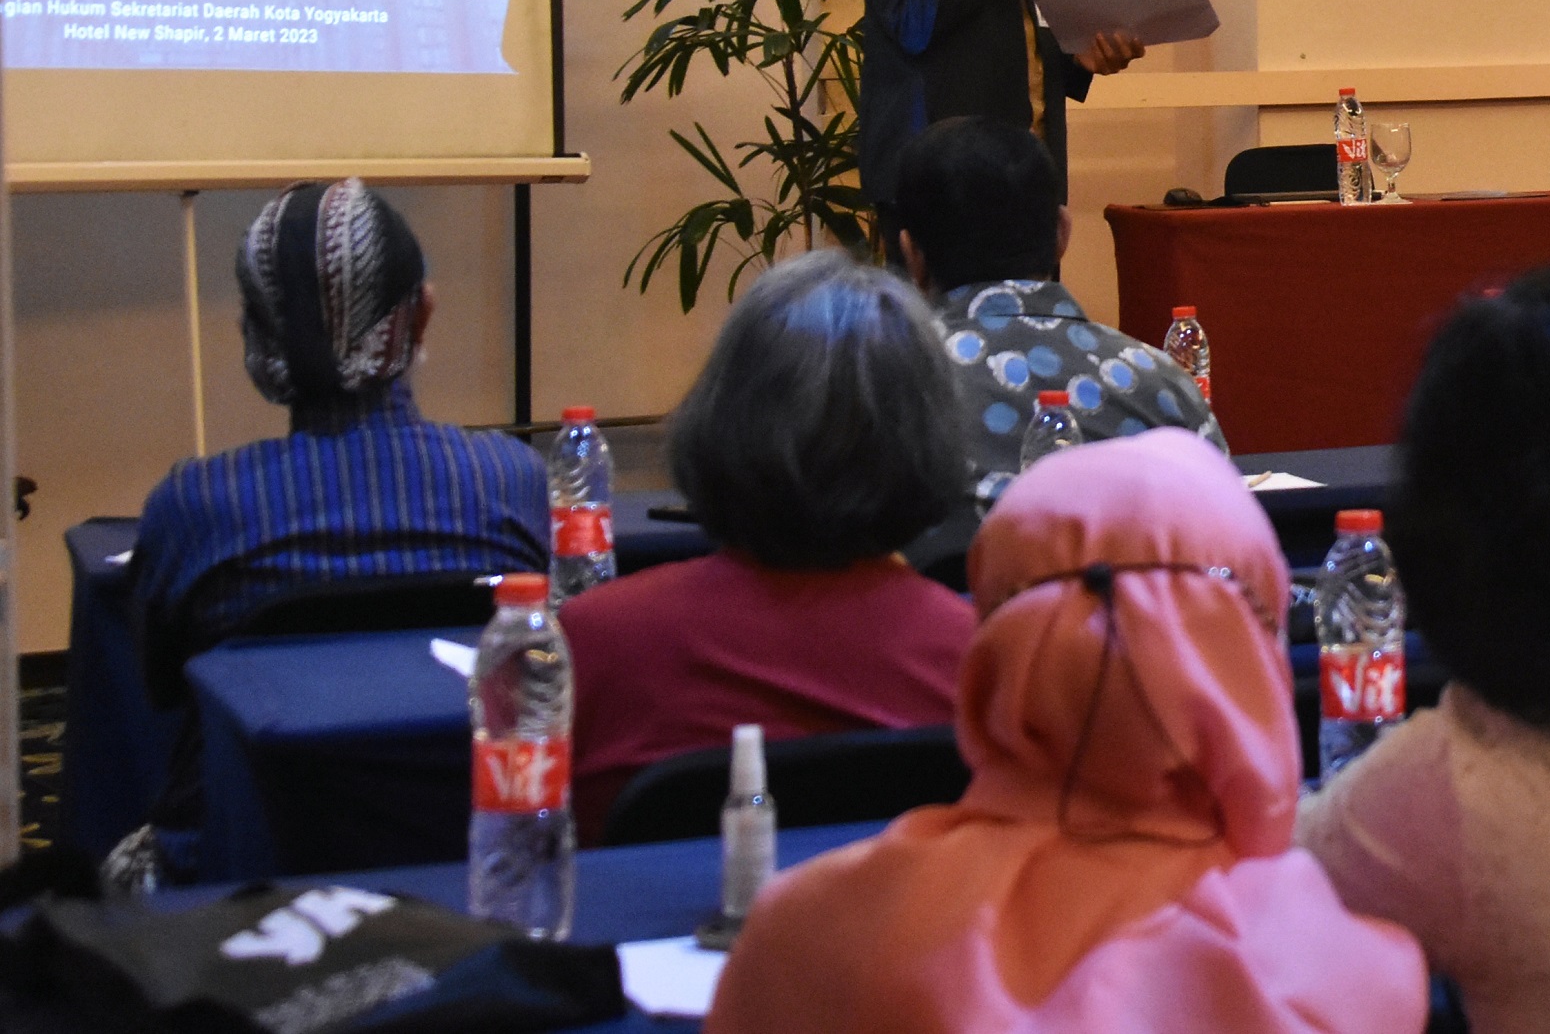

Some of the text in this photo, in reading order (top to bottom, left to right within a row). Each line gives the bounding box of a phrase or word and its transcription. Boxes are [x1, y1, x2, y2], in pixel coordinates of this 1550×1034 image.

[0, 0, 389, 25] gian Hukum Sekretariat Daerah Kota Yogyakarta
[64, 23, 318, 44] Hotel New Shapir, 2 Maret 2023
[1342, 139, 1367, 159] Vit
[1330, 653, 1402, 713] Vit
